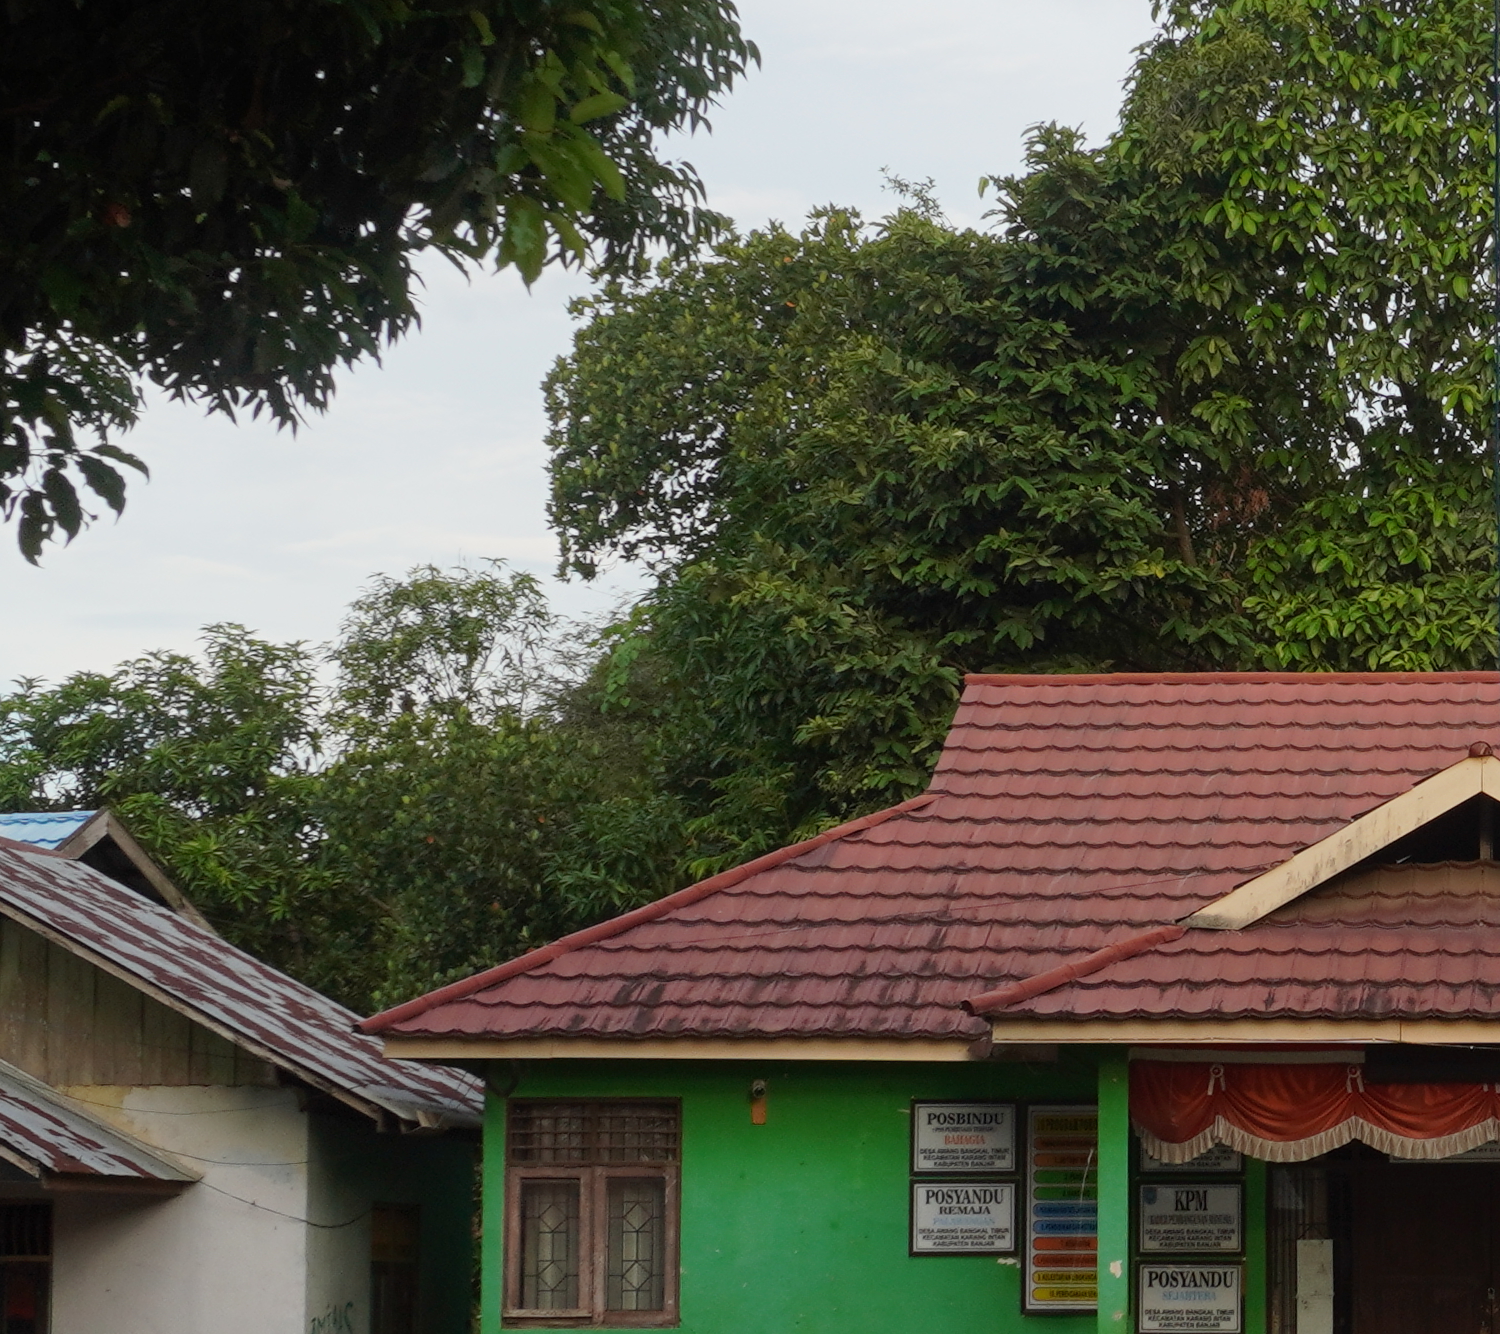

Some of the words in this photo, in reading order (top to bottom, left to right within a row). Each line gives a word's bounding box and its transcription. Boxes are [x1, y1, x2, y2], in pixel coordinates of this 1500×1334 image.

[927, 1113, 1004, 1125] POSBINDU
[925, 1189, 1004, 1204] POSYANDU
[1174, 1191, 1208, 1211] KPM
[939, 1206, 990, 1215] REMAJA
[1148, 1271, 1234, 1287] POSYANDU
